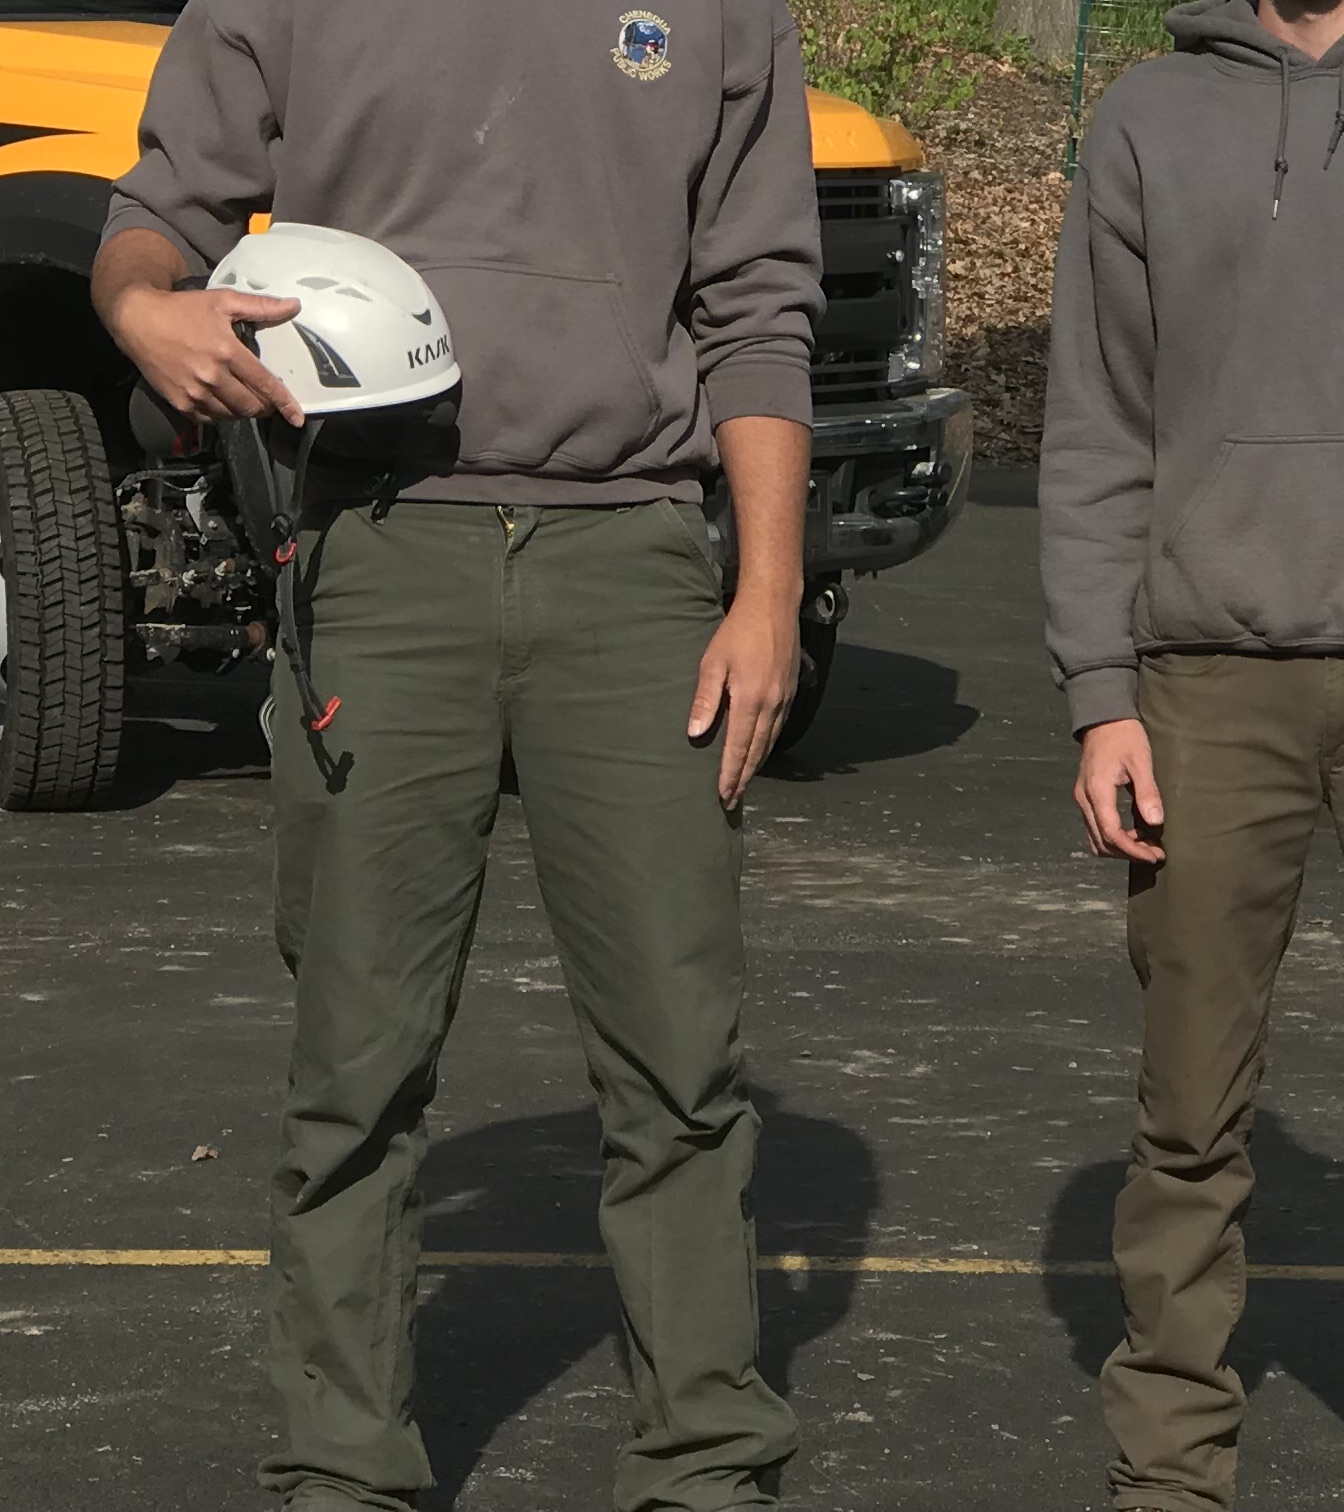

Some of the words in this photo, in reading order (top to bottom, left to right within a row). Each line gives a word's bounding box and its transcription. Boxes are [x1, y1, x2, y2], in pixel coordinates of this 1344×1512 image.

[618, 9, 672, 35] CHENEQUA
[609, 47, 637, 79] PUBLIC
[638, 59, 672, 81] WORKS
[407, 334, 451, 369] KASK
